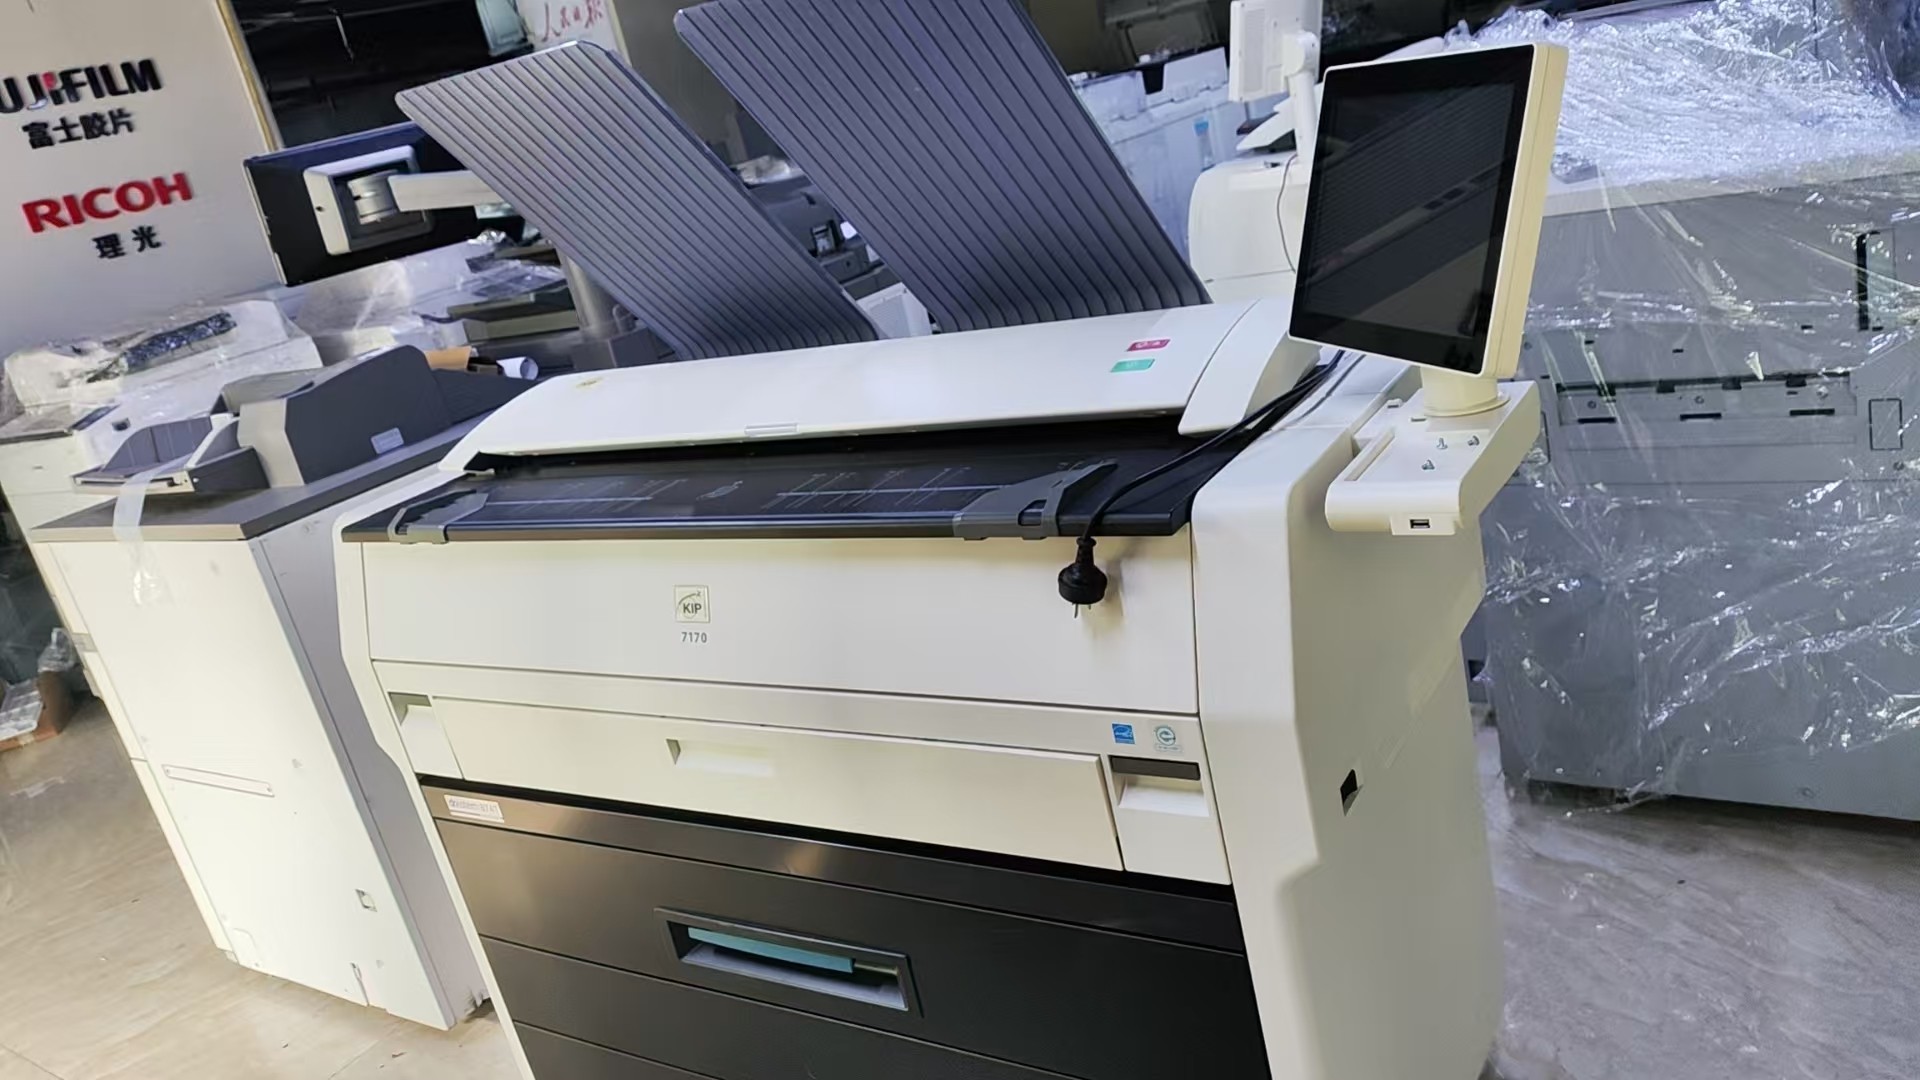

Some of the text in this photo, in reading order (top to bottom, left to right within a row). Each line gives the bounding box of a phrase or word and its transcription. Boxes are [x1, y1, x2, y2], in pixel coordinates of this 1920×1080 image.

[22, 107, 134, 149] 富士胶片
[22, 172, 193, 233] RICOH
[92, 225, 162, 259] 理光
[682, 602, 702, 614] KIP
[681, 631, 708, 643] 7170
